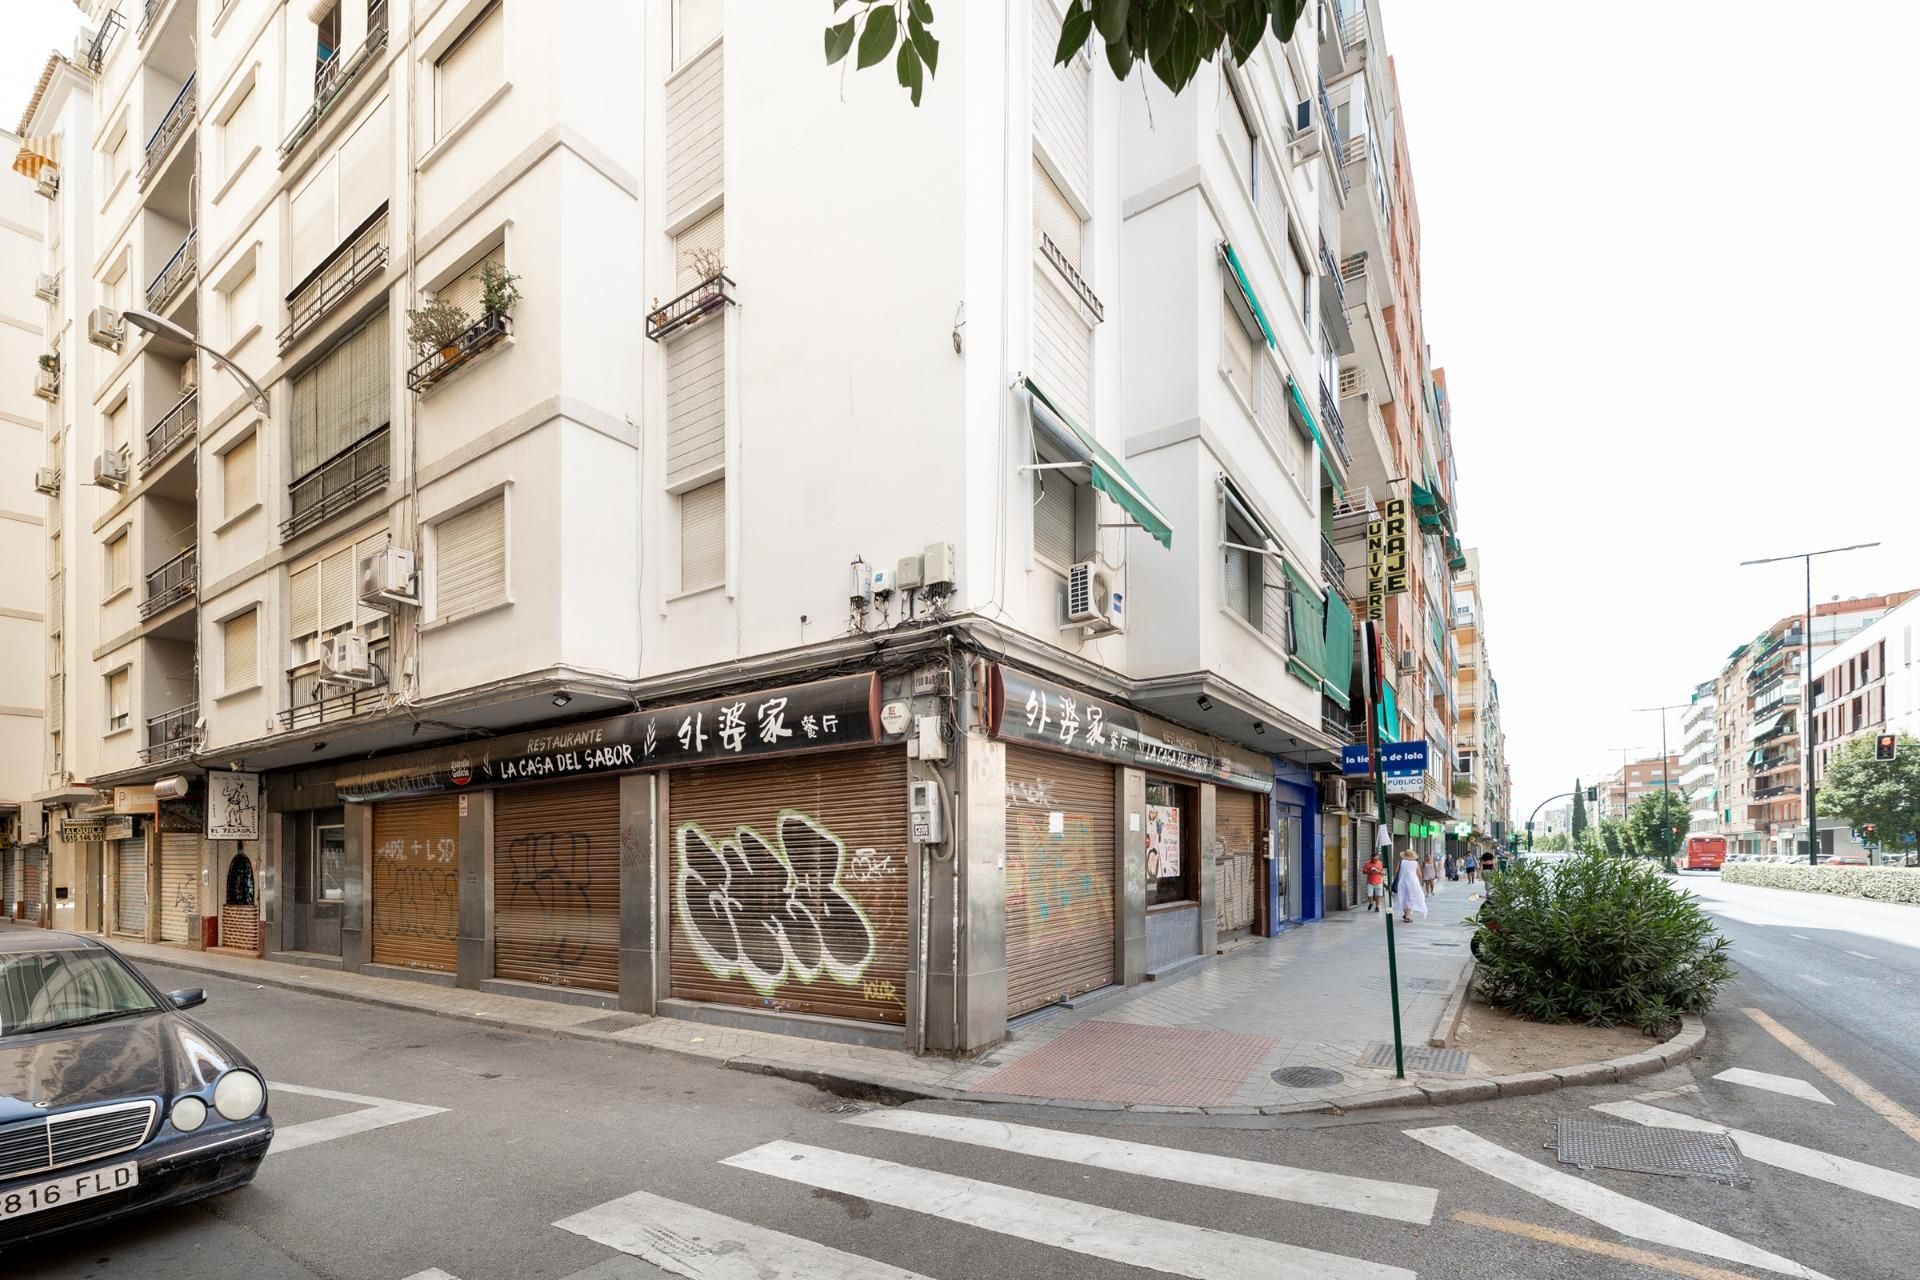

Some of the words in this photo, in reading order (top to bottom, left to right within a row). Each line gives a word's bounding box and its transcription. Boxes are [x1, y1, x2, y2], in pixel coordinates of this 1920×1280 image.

[678, 697, 793, 752] 外婆家
[1025, 688, 1106, 747] 外婆家
[527, 728, 603, 754] RESTAURANTE
[500, 761, 517, 779] LA
[519, 756, 555, 776] CASA
[556, 751, 582, 772] DEL
[585, 743, 634, 769] SABOR
[1157, 746, 1176, 766] CASA
[1346, 756, 1355, 764] la
[1357, 755, 1387, 763] tiea
[1390, 753, 1402, 761] de
[1404, 752, 1423, 760] lola
[1387, 777, 1423, 786] PÚBLICO
[66, 827, 103, 835] ALQUILA
[426, 838, 456, 862] LSD
[0, 1184, 61, 1217] 816
[75, 1167, 131, 1198] FLD
